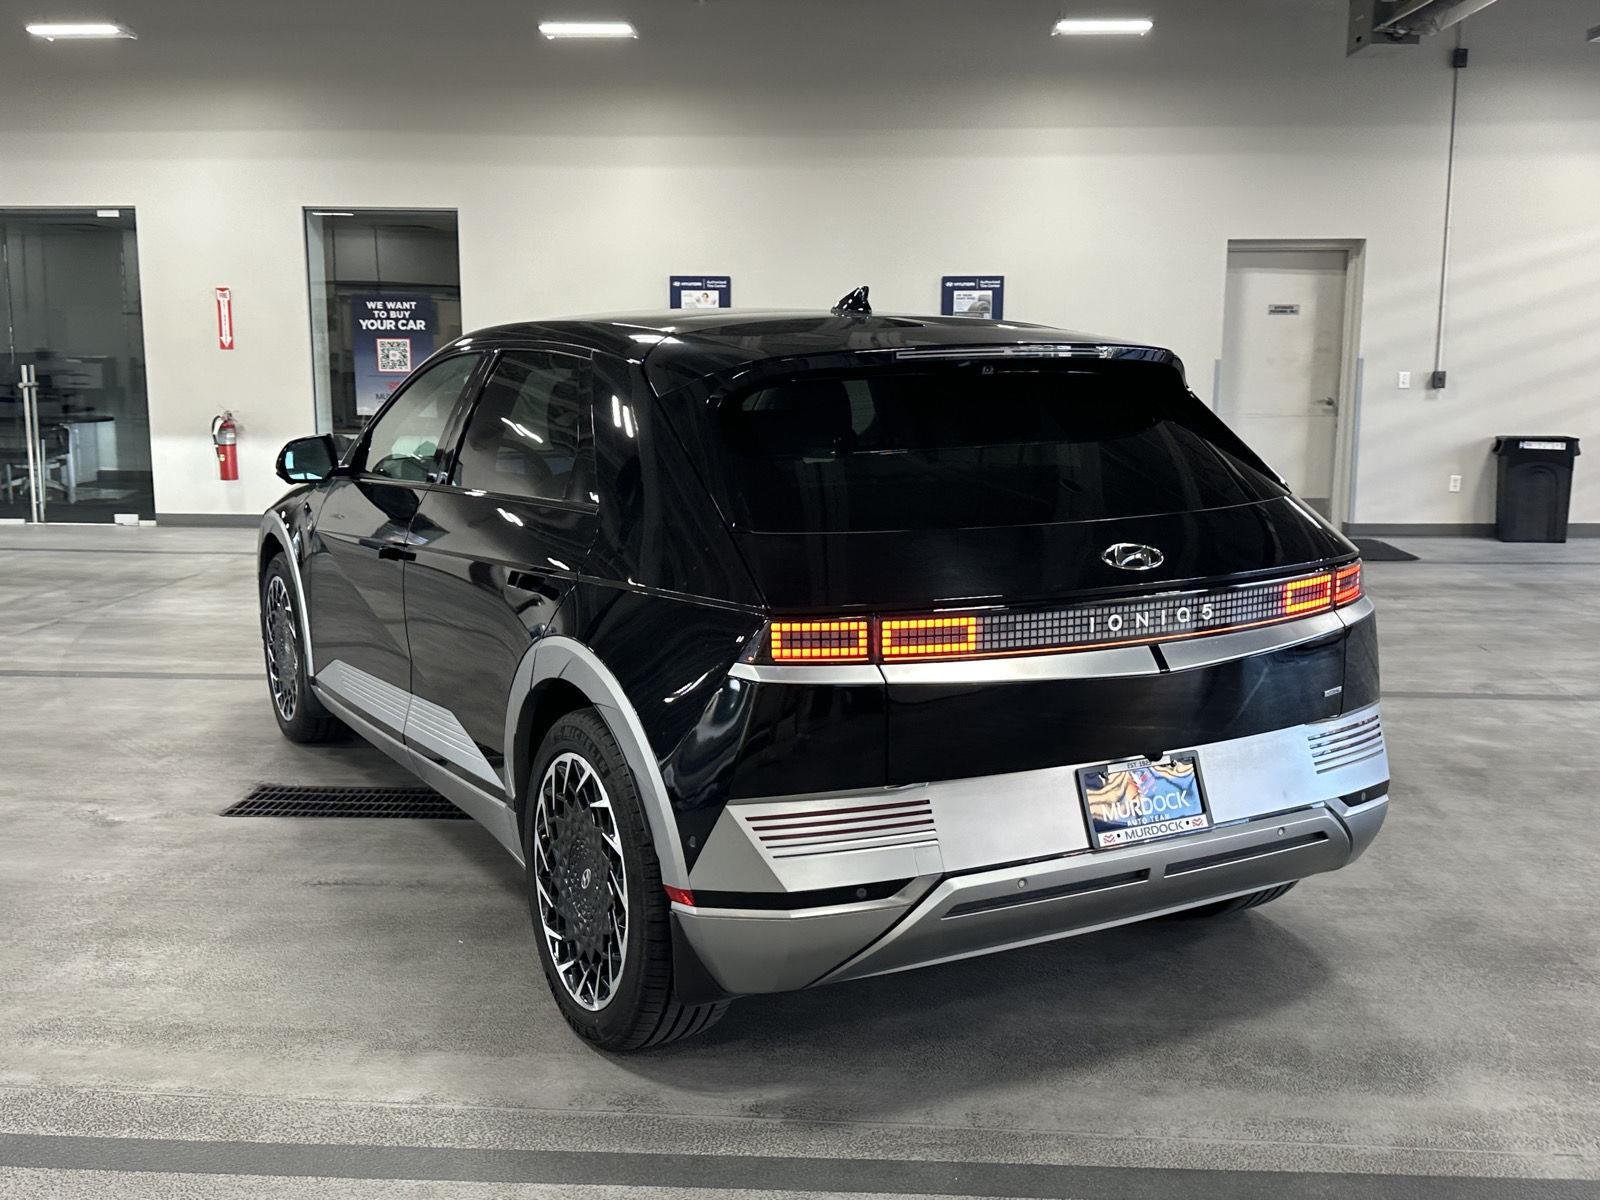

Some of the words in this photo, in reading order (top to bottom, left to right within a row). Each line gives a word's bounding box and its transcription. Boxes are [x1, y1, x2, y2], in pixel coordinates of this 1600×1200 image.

[366, 301, 383, 310] WE
[385, 301, 417, 310] WANT
[373, 310, 387, 319] TO
[390, 310, 411, 319] BUY
[359, 319, 396, 330] YOUR
[398, 319, 426, 331] CAR
[1100, 789, 1190, 822] MURDOCK
[1127, 817, 1148, 827] AUTO
[1149, 813, 1170, 822] TEAM
[1124, 820, 1184, 840] MURDOCK
